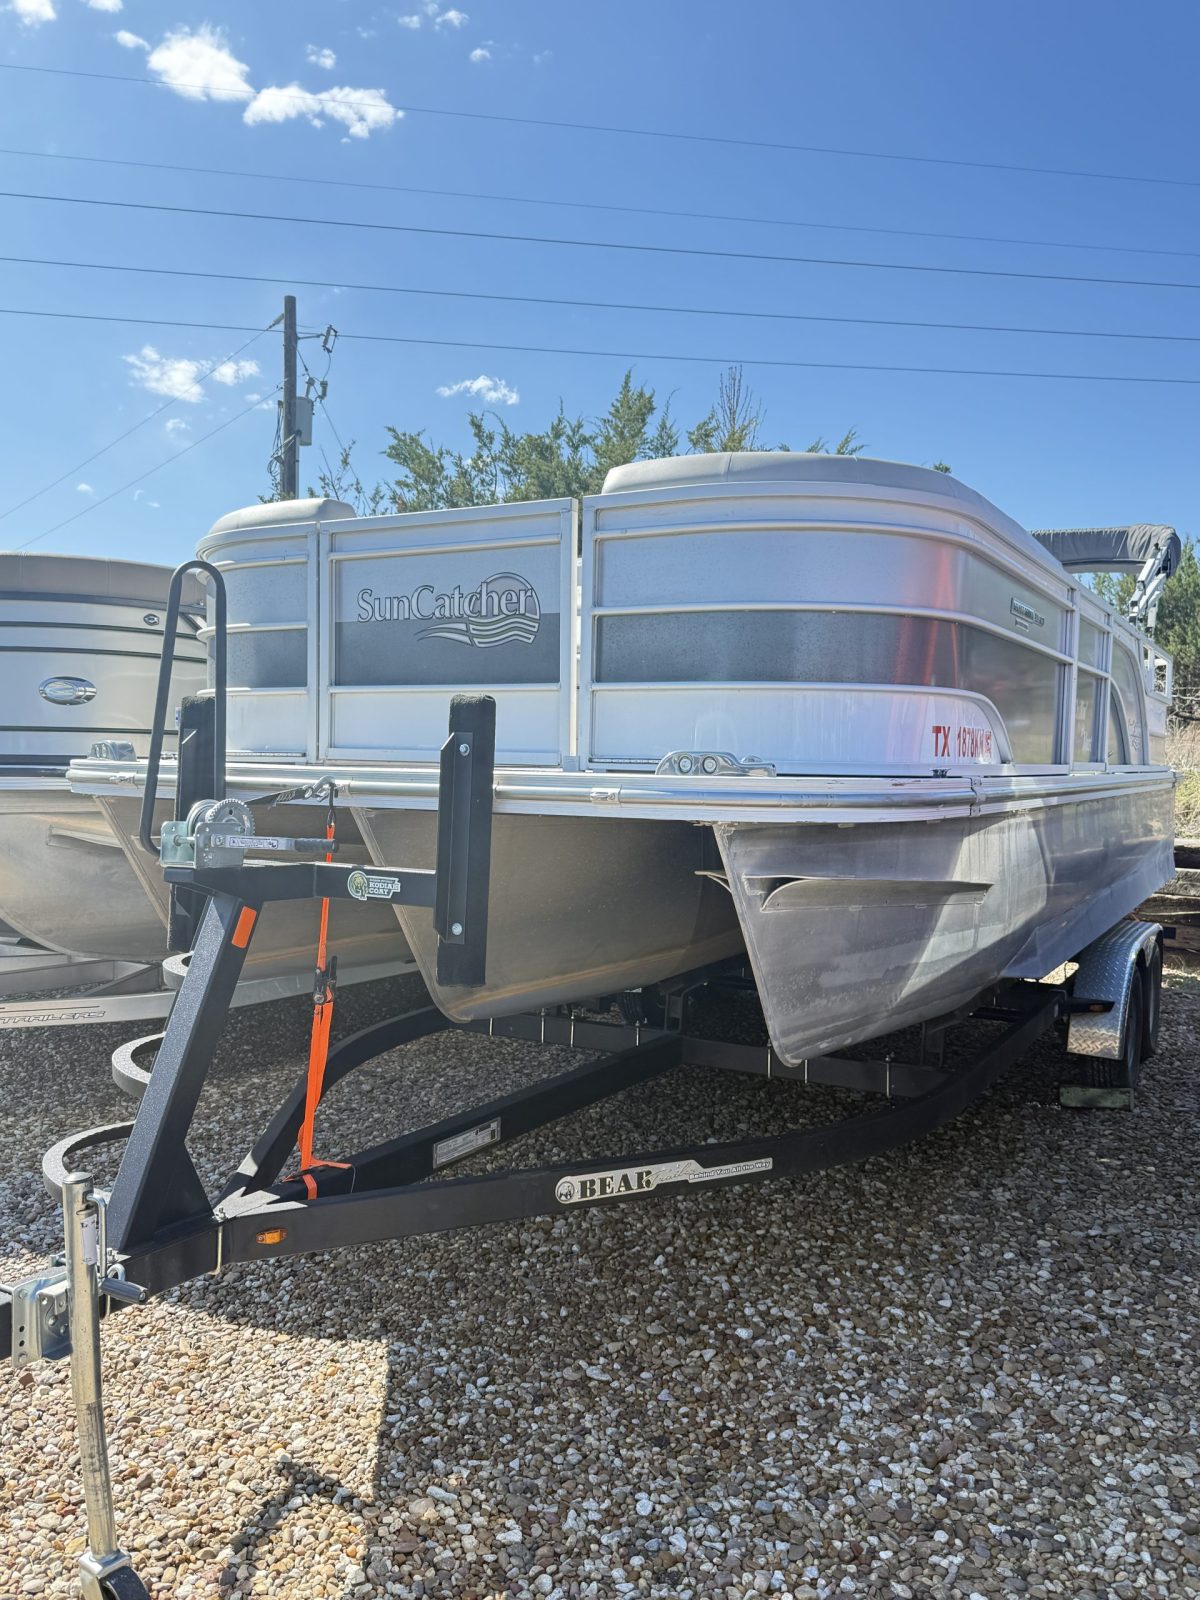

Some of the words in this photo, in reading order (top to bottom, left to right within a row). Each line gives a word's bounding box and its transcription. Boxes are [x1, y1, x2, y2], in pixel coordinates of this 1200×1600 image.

[357, 582, 533, 623] SunCatcher
[932, 726, 950, 757] TX
[0, 1011, 106, 1024] TRAILERS
[689, 1170, 715, 1180] Behind
[716, 1168, 730, 1176] You
[742, 1163, 754, 1171] the
[755, 1160, 771, 1169] Way
